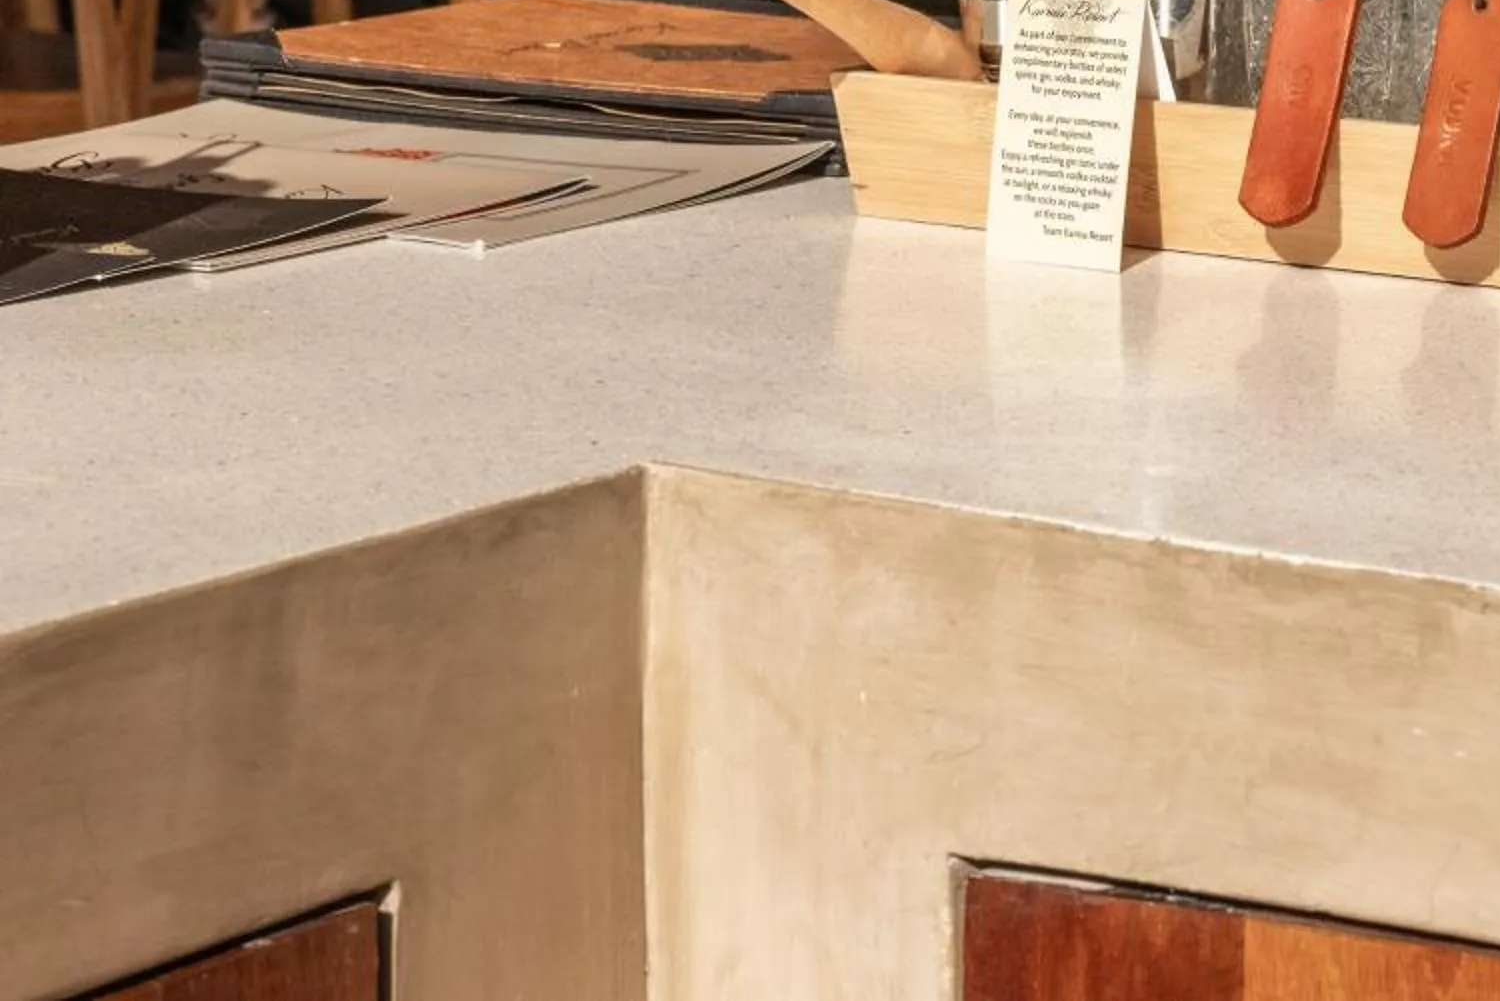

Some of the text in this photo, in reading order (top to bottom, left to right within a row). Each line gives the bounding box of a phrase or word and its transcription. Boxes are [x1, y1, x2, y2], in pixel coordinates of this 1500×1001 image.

[1029, 30, 1044, 39] part
[1054, 31, 1068, 42] our
[1069, 34, 1116, 46] commitment
[1013, 42, 1051, 56] enhancing
[1051, 43, 1070, 56] your
[1099, 51, 1128, 61] provide
[1012, 56, 1067, 70] complimentary
[1068, 58, 1095, 71] bottles
[1104, 64, 1127, 75] select
[1078, 75, 1095, 86] and
[1030, 83, 1042, 94] for
[1042, 87, 1060, 97] your
[1007, 108, 1028, 121] Every
[1054, 115, 1072, 125] your
[1044, 126, 1058, 137] will
[1059, 129, 1092, 140] replenish
[1027, 139, 1048, 149] these
[1048, 141, 1074, 153] bottles
[1000, 148, 1021, 162] Enjoy
[1027, 152, 1064, 167] refreshing
[1097, 161, 1120, 171] under
[1000, 163, 1014, 173] the
[1036, 168, 1064, 179] smooth
[1065, 170, 1088, 181] vodka
[1089, 174, 1117, 184] cocktail
[1057, 184, 1086, 197] relaxing
[1023, 193, 1036, 203] the
[1036, 196, 1056, 206] rocks
[1066, 199, 1081, 209] you
[1080, 201, 1100, 212] gaze
[1043, 209, 1057, 219] the
[1042, 224, 1062, 236] Team
